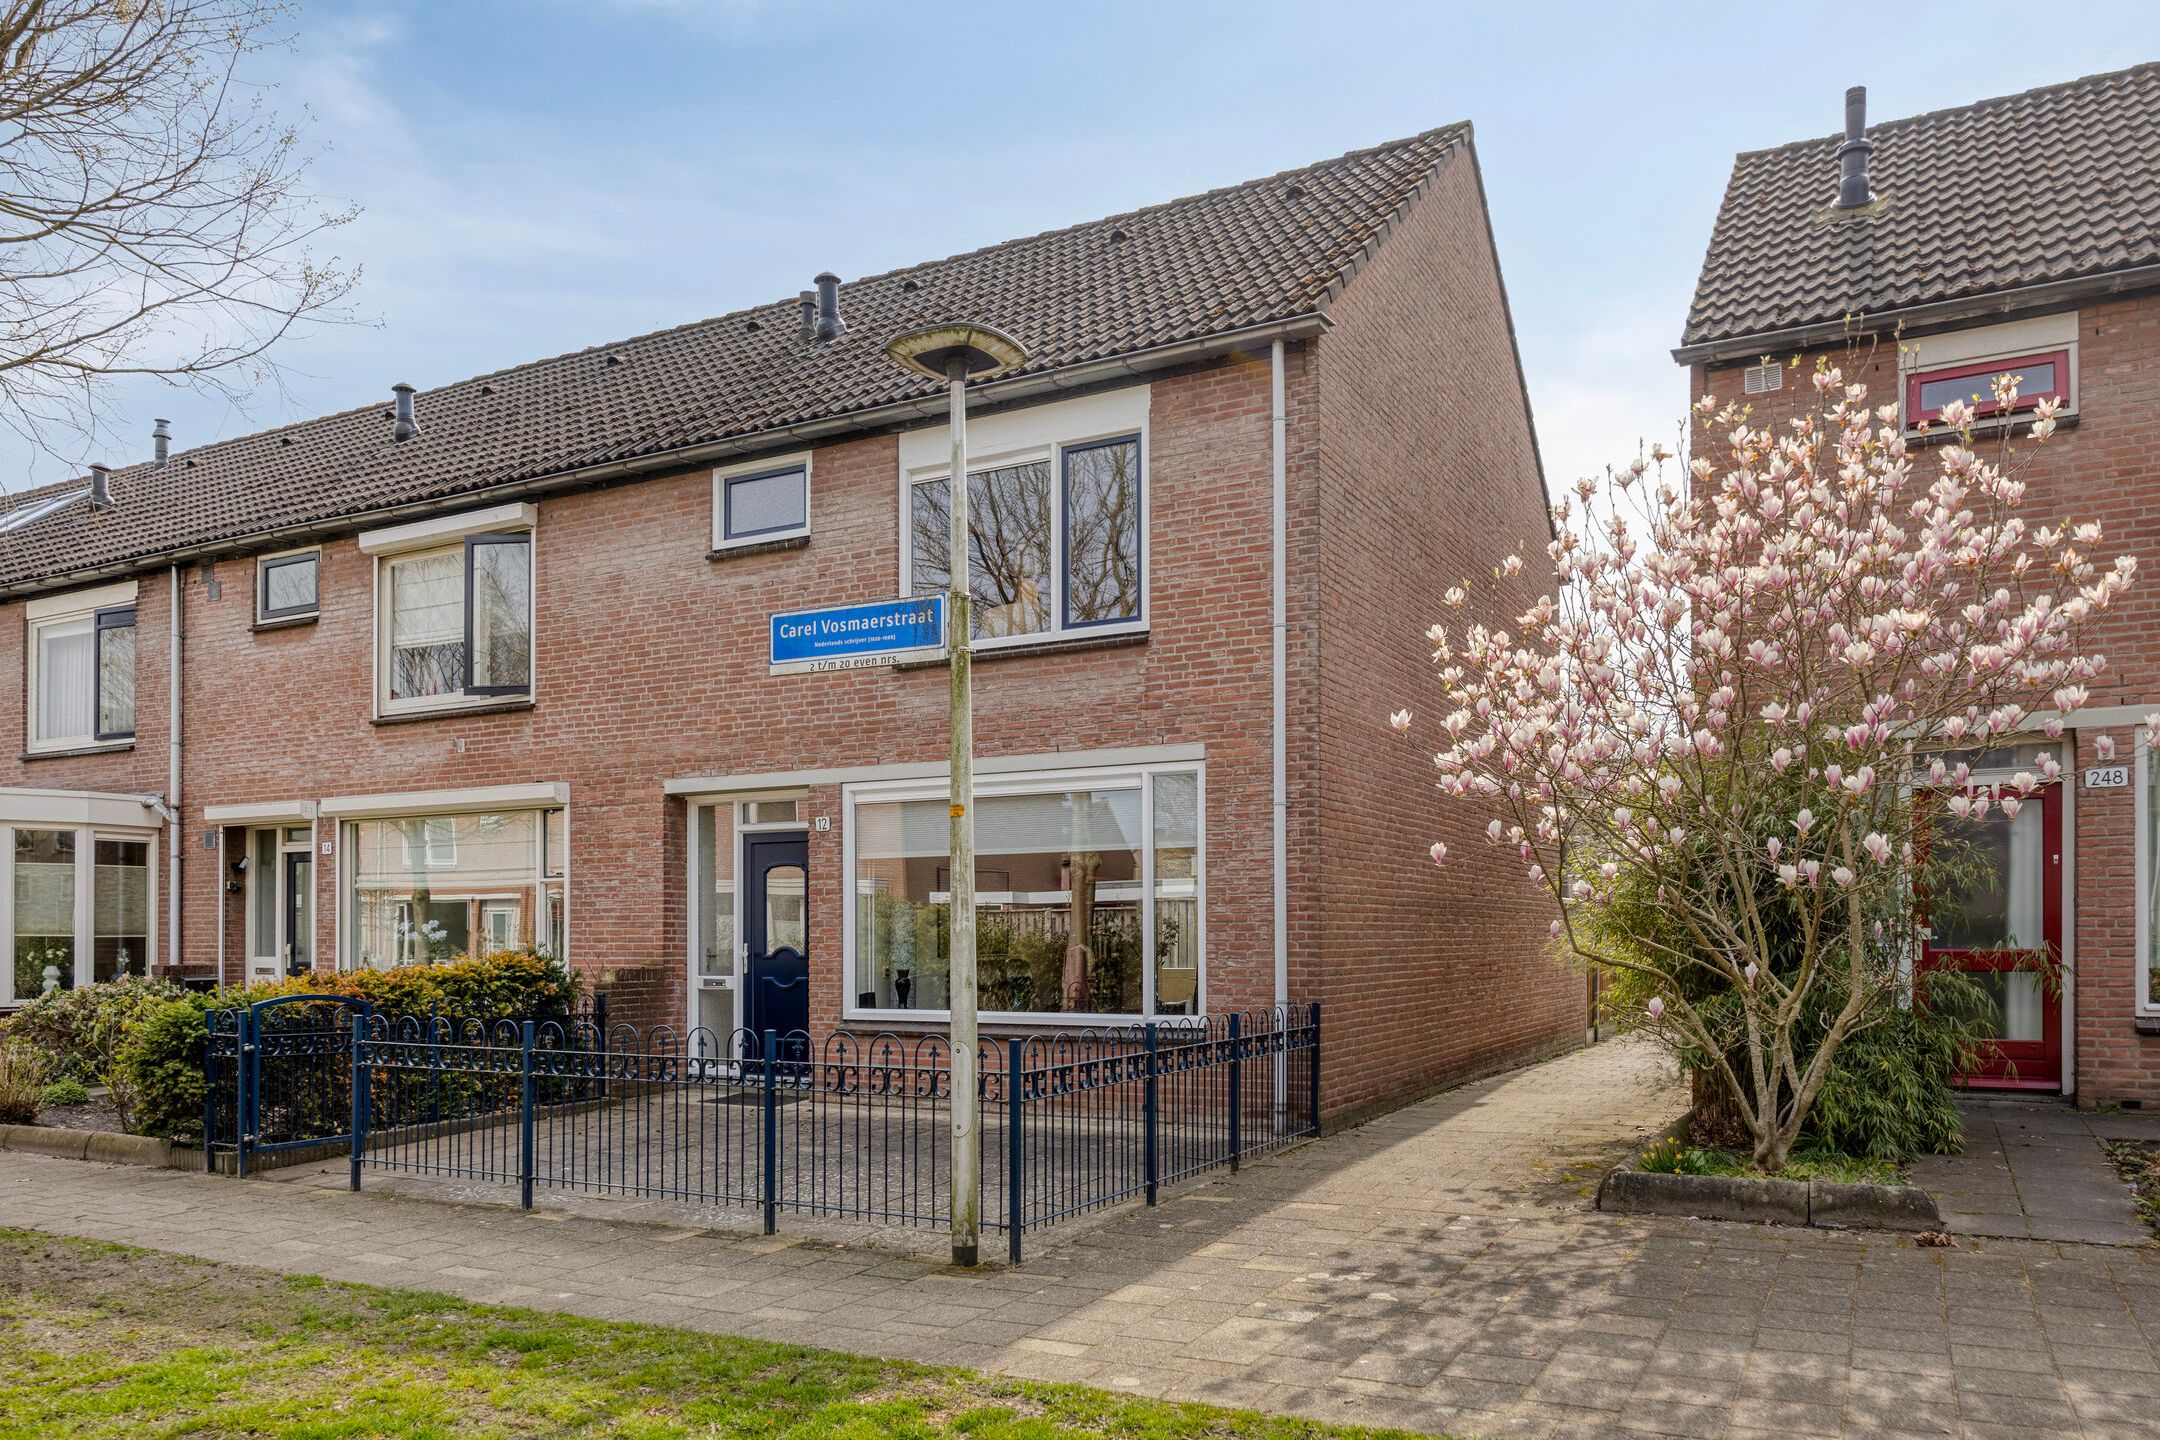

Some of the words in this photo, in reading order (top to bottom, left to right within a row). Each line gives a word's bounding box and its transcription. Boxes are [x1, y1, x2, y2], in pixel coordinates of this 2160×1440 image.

[780, 620, 817, 639] Carel
[821, 608, 934, 634] Vosmaerstraat
[814, 639, 844, 648] Nederlands
[844, 637, 867, 646] schrijver
[810, 664, 815, 672] 2
[818, 661, 836, 671] t/m
[840, 660, 850, 669] 20
[854, 658, 877, 668] even
[881, 655, 900, 665] nrs.
[2090, 770, 2124, 786] 248
[818, 817, 828, 831] 12
[323, 843, 331, 854] 14
